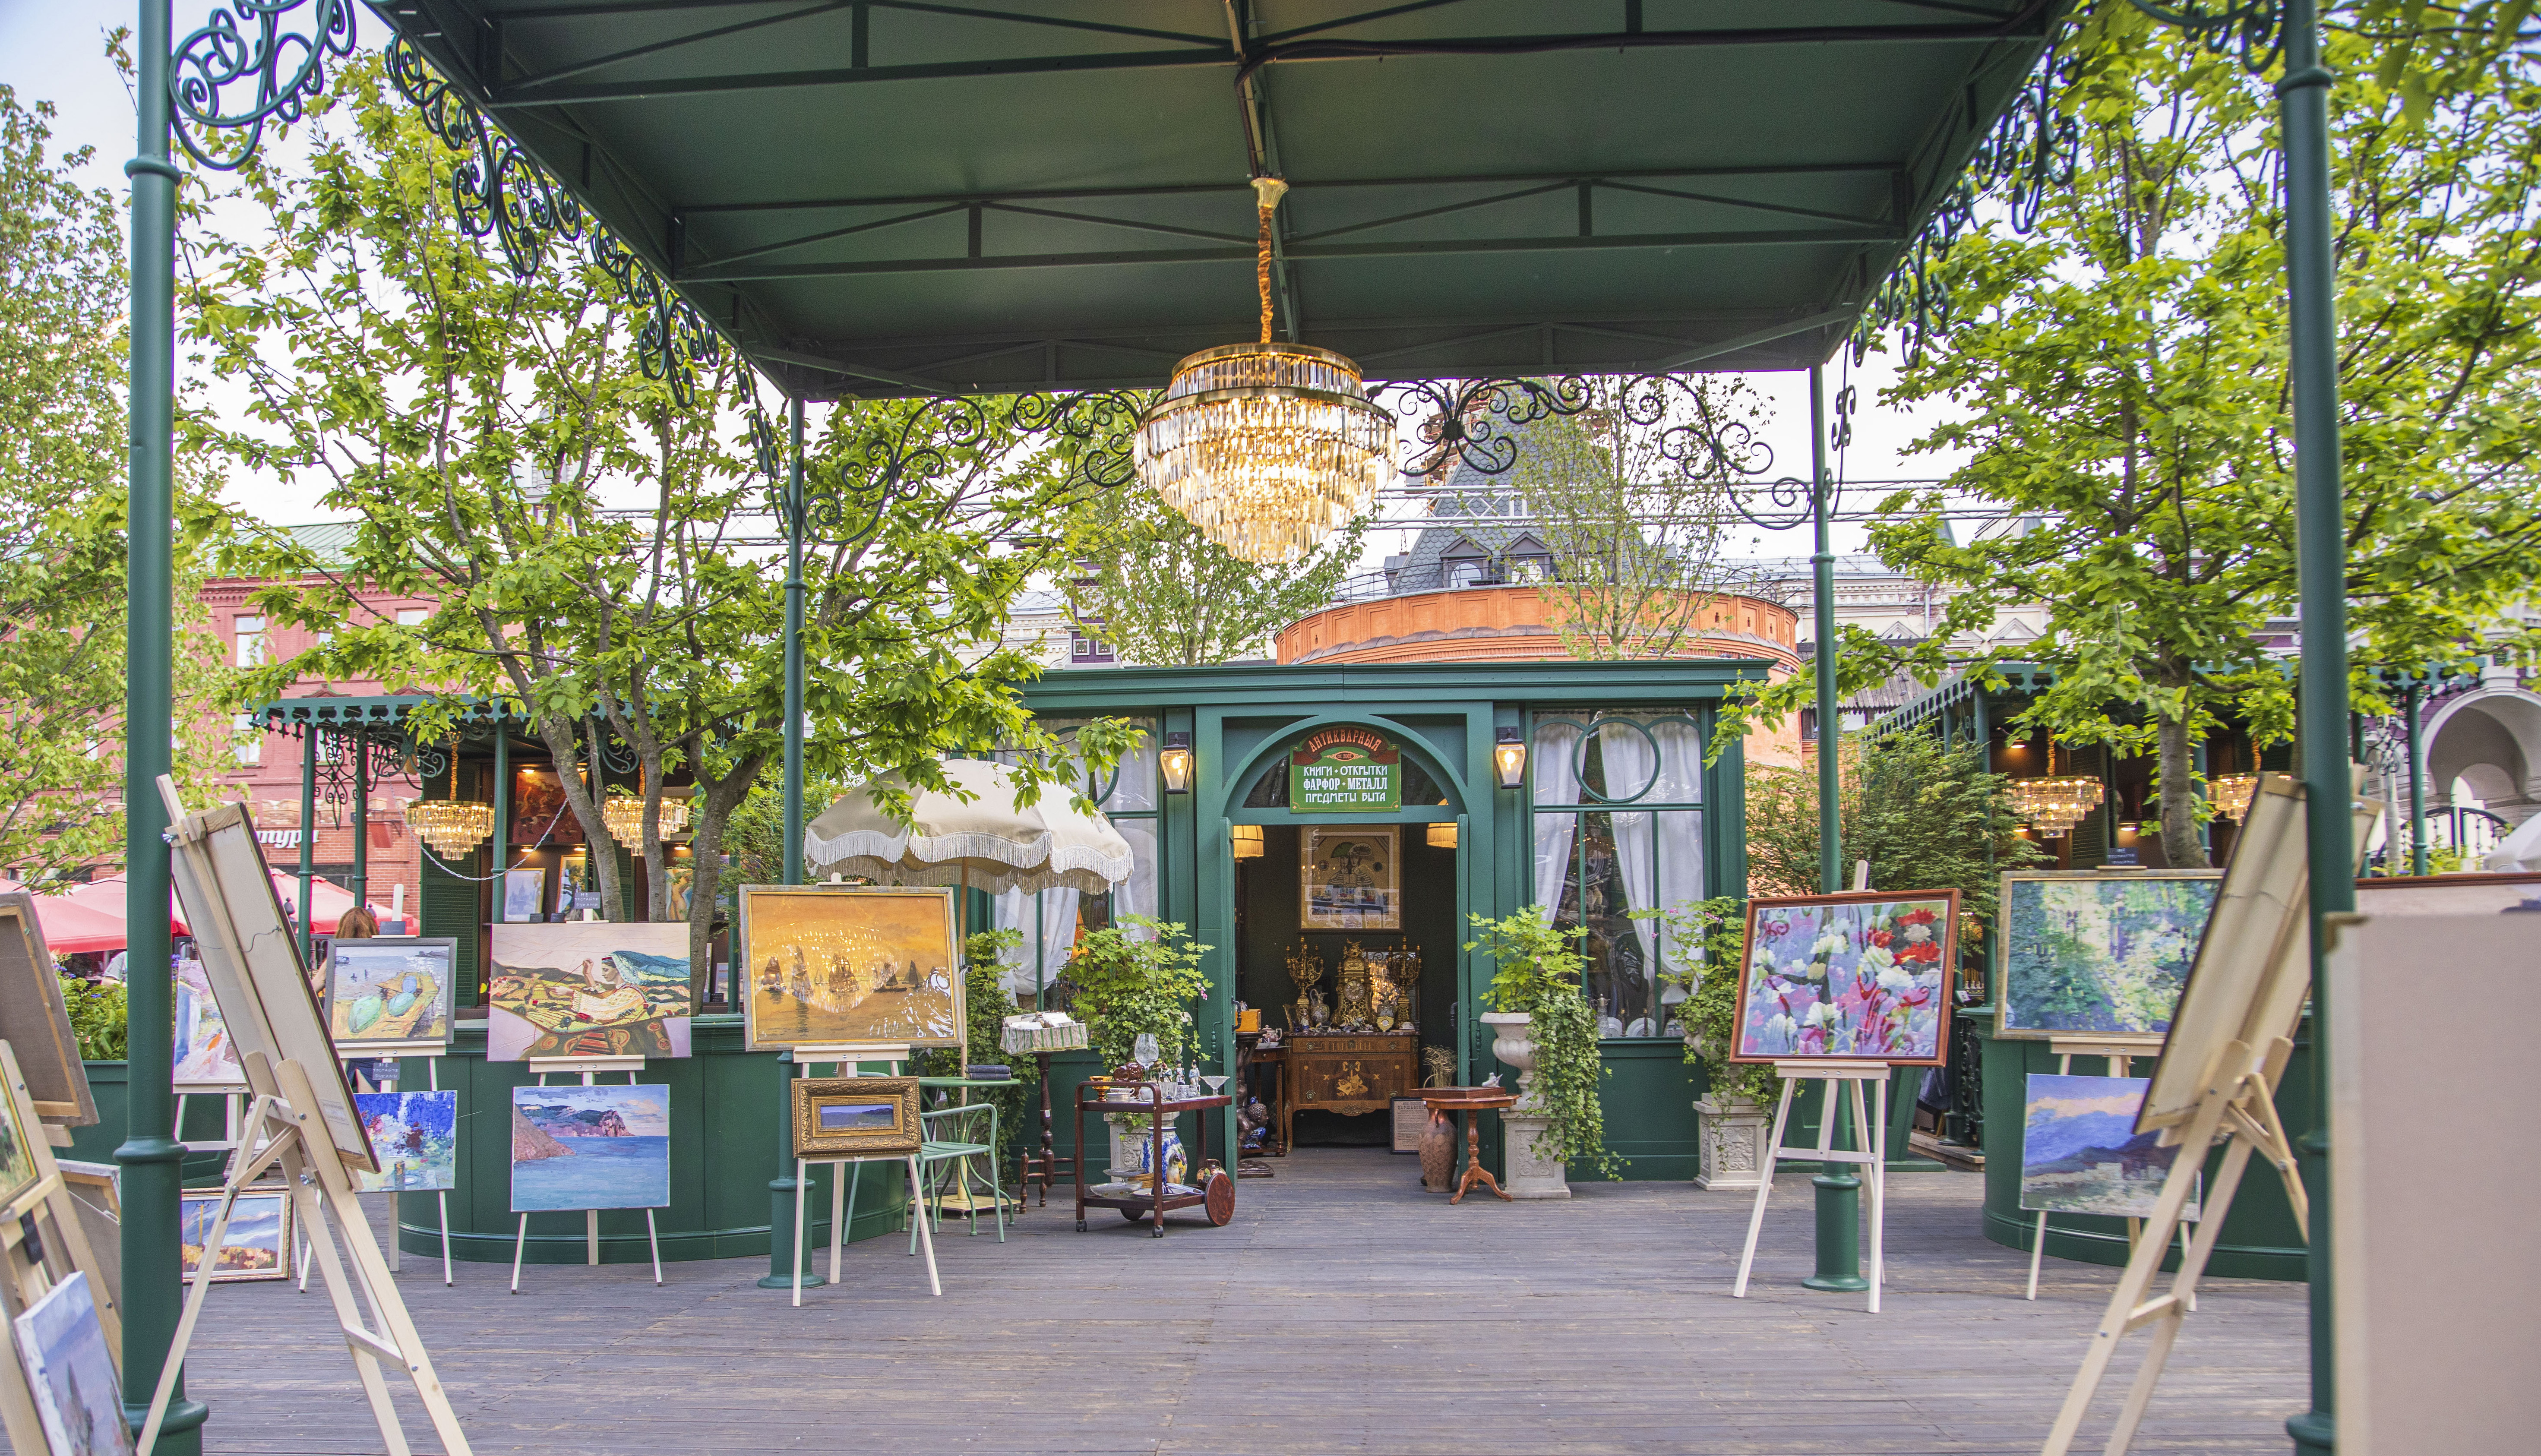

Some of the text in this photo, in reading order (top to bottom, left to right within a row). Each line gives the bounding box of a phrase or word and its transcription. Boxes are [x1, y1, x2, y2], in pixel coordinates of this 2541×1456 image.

[1308, 729, 1381, 752] АНТИКВАРНЫЯ
[1304, 766, 1387, 776] КНИГИ ОТКРЫТКИ
[1303, 777, 1387, 790] ФАРФОР МЕТАЛЛ
[1306, 792, 1386, 804] ПРЕДМЕТЫ БЫТА
